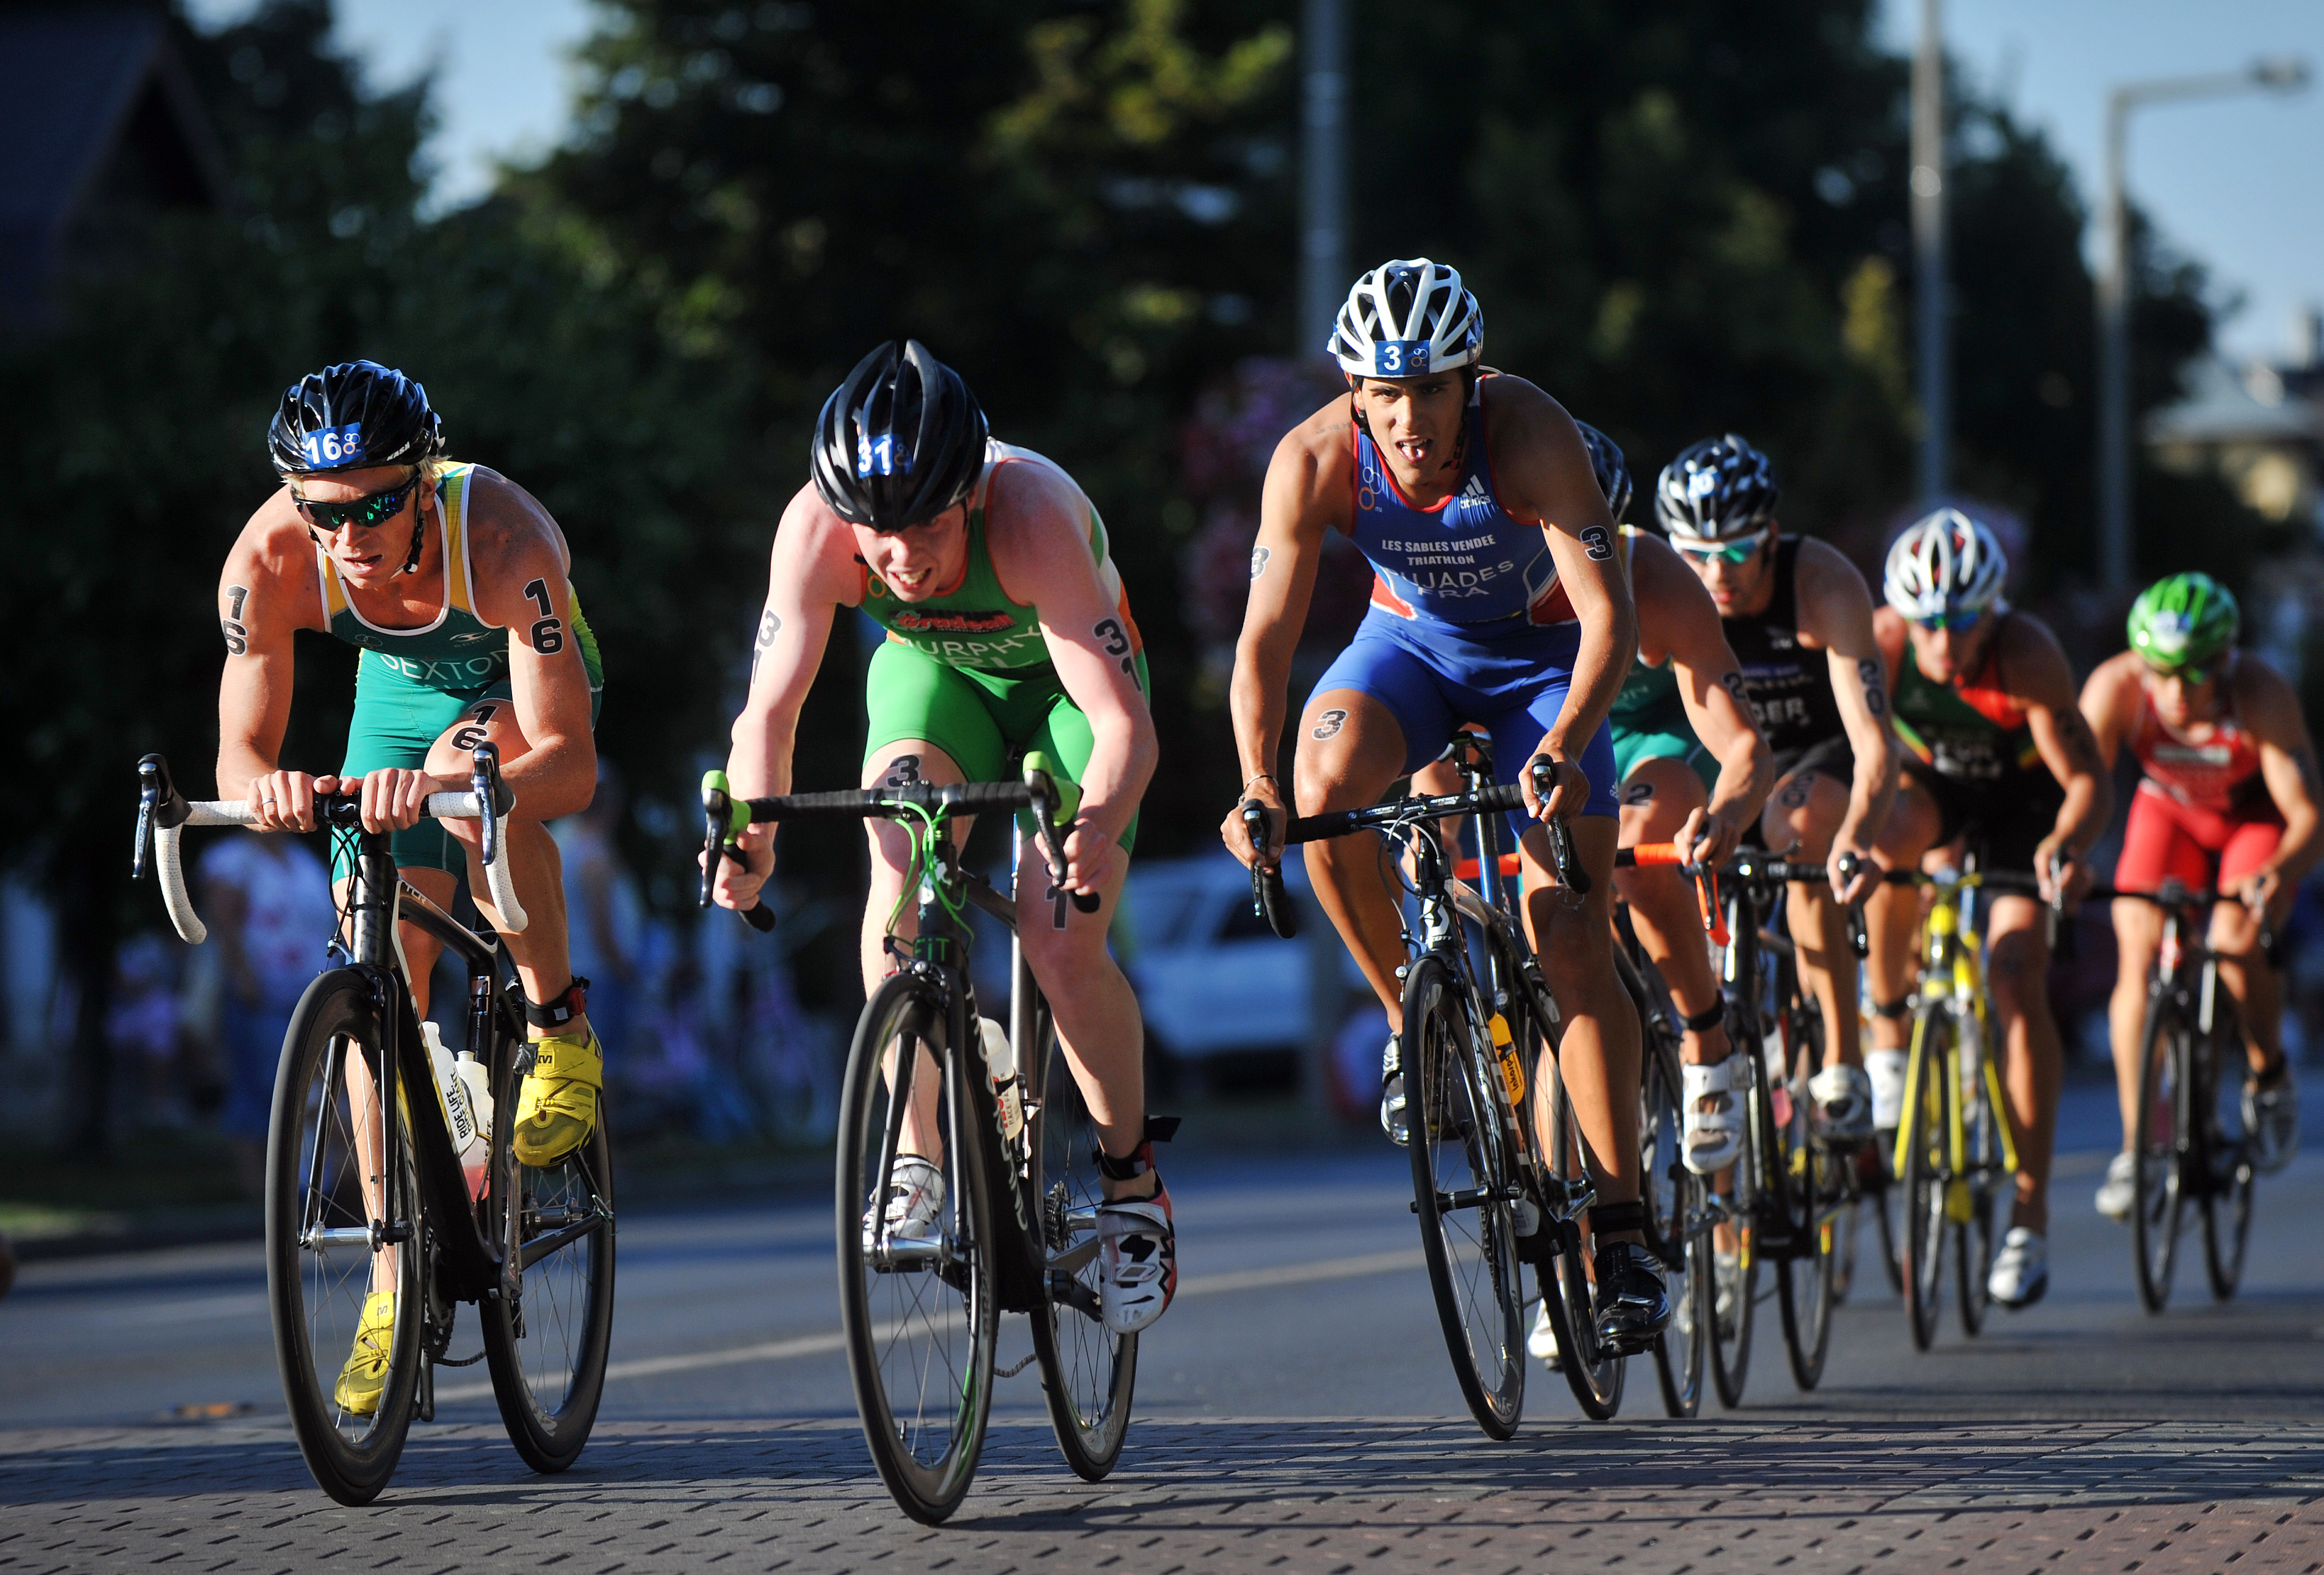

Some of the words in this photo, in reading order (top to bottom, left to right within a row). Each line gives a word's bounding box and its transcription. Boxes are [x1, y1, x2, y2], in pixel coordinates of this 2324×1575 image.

[1384, 345, 1401, 371] 3
[305, 432, 342, 465] 16
[857, 436, 890, 472] 31
[1382, 539, 1402, 551] LES
[1405, 541, 1449, 552] SABLES
[1450, 534, 1496, 552] VENDEE
[1579, 525, 1614, 561] 3
[1250, 545, 1271, 581] 3
[1407, 554, 1476, 566] TRIATHLON
[1418, 585, 1490, 599] FRA
[1312, 709, 1349, 741] 3
[405, 882, 428, 905] TCR
[454, 1113, 468, 1140] RIDE
[1006, 1102, 1016, 1126] RACE
